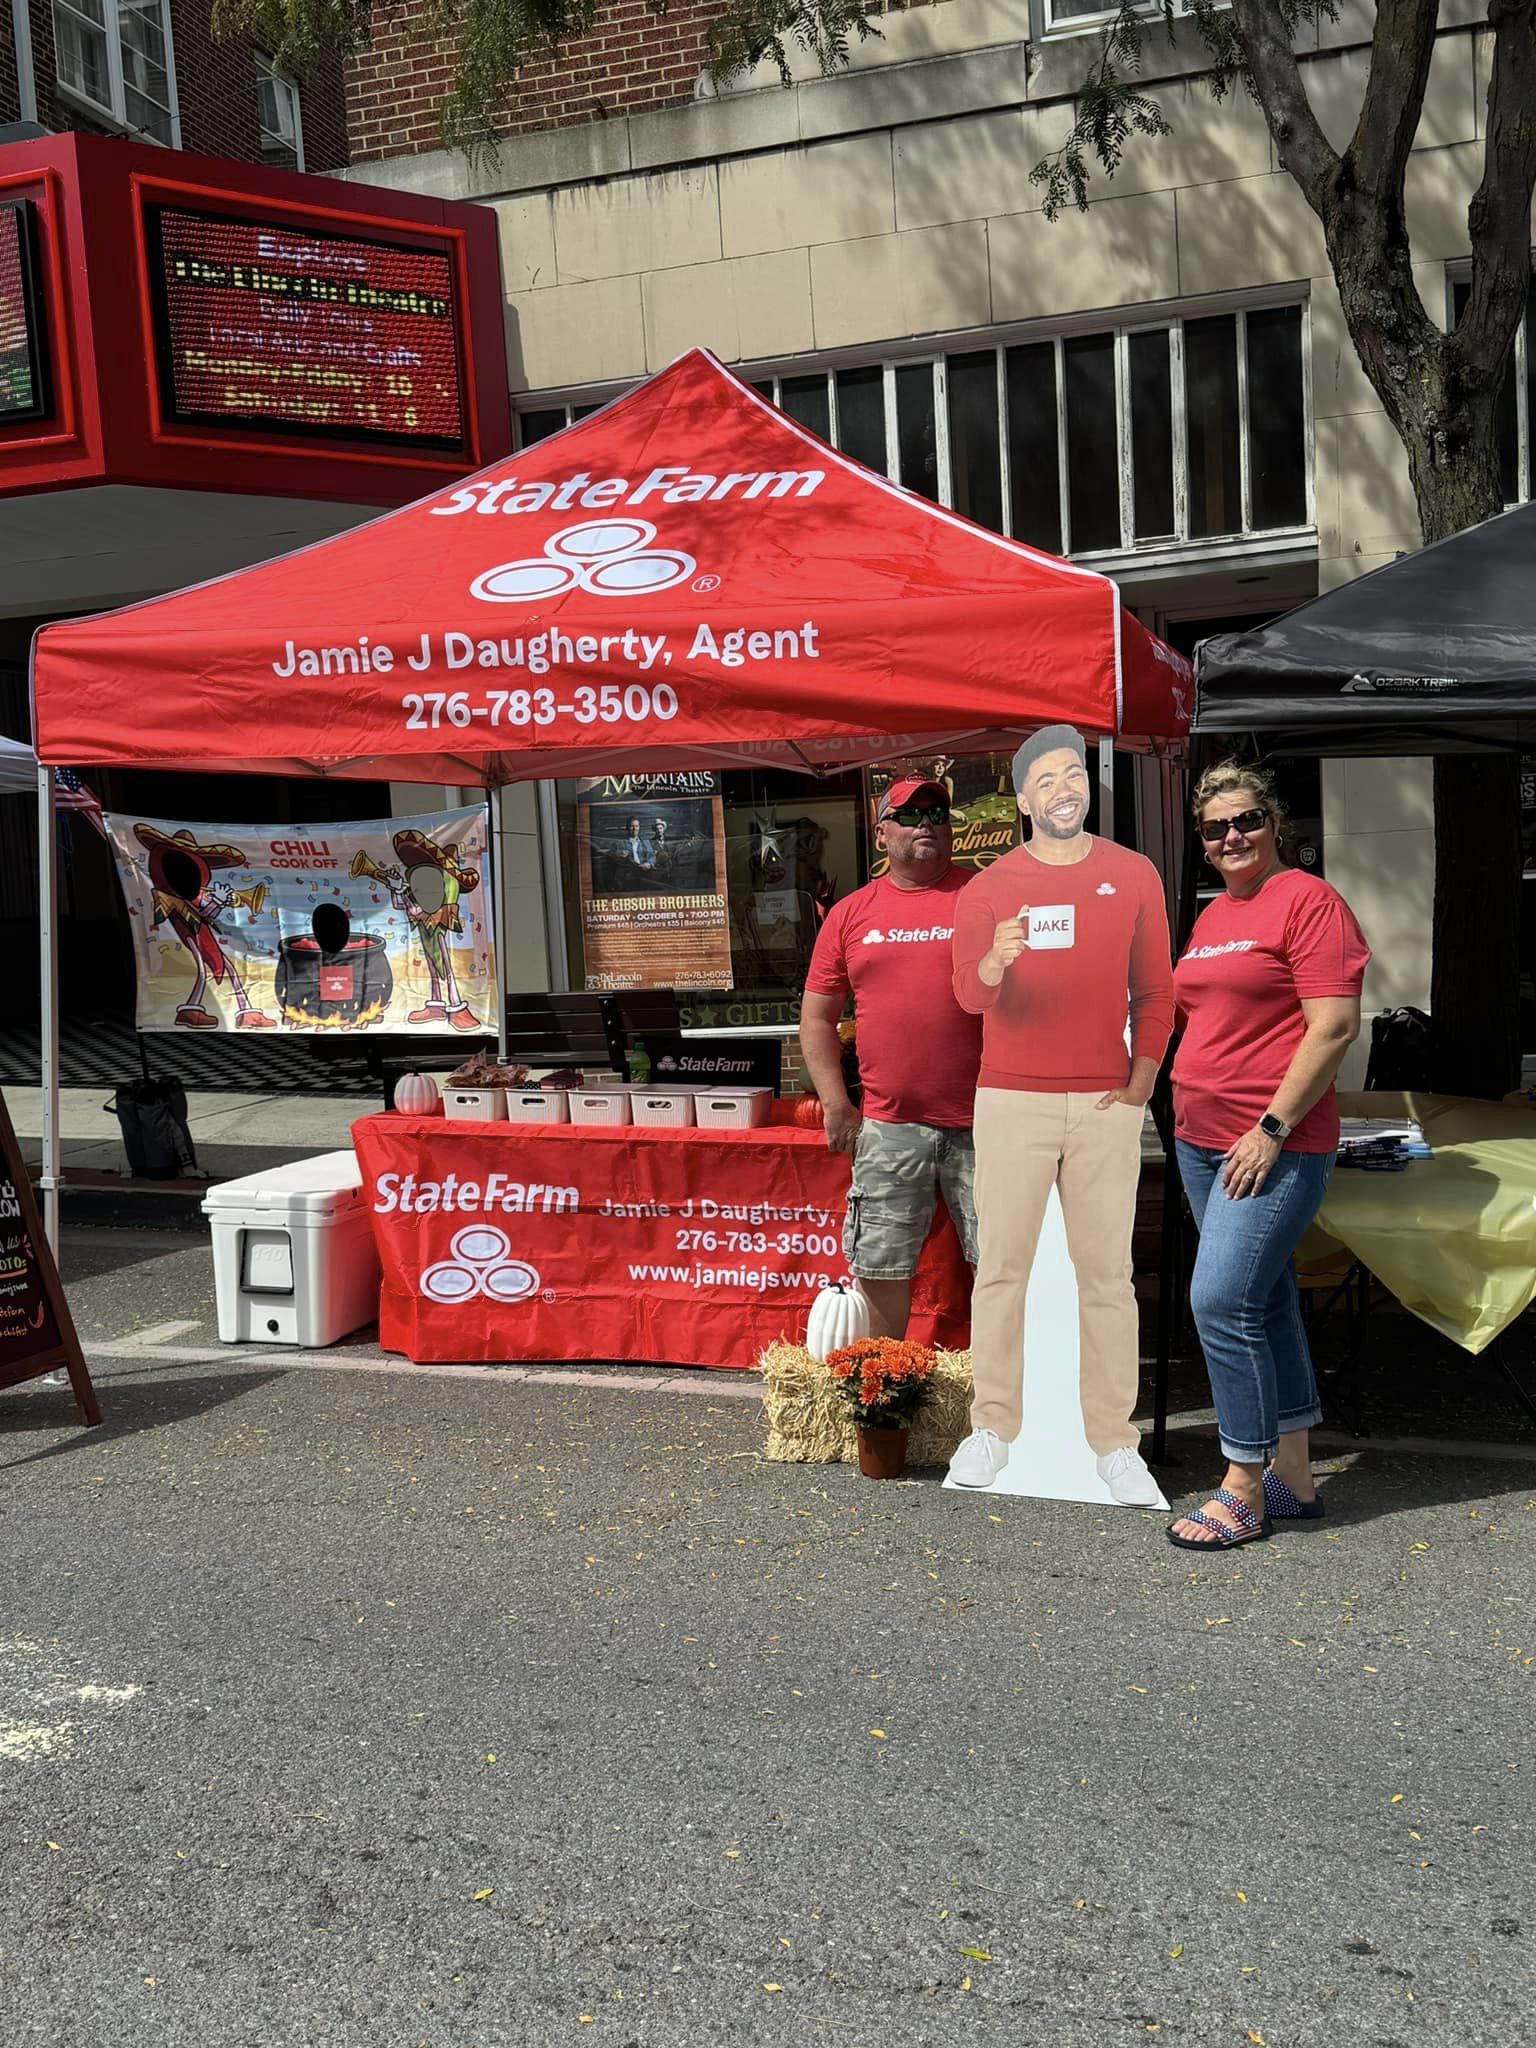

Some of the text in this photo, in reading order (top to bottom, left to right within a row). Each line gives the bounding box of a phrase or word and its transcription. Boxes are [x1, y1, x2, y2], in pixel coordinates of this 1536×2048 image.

[272, 620, 821, 678] Jamie J Daugherty, Agent
[1375, 677, 1460, 687] OZARK TRAIL
[402, 683, 679, 731] 276-783-3500
[602, 770, 715, 797] MOUNTAINS
[269, 840, 331, 856] CHILI
[270, 858, 338, 869] COOK OFF
[585, 894, 725, 912] THE GIBSON BROTHERS
[587, 914, 631, 922] SATURDAY
[1033, 919, 1070, 933] JAKE
[885, 925, 956, 943] StateFar
[726, 1002, 801, 1026] GIFTS
[678, 1056, 750, 1073] StateFarm
[374, 1173, 580, 1214] StateFarm
[598, 1199, 837, 1228] Jamie J Daugherty,
[676, 1229, 837, 1256] 276-783-3500
